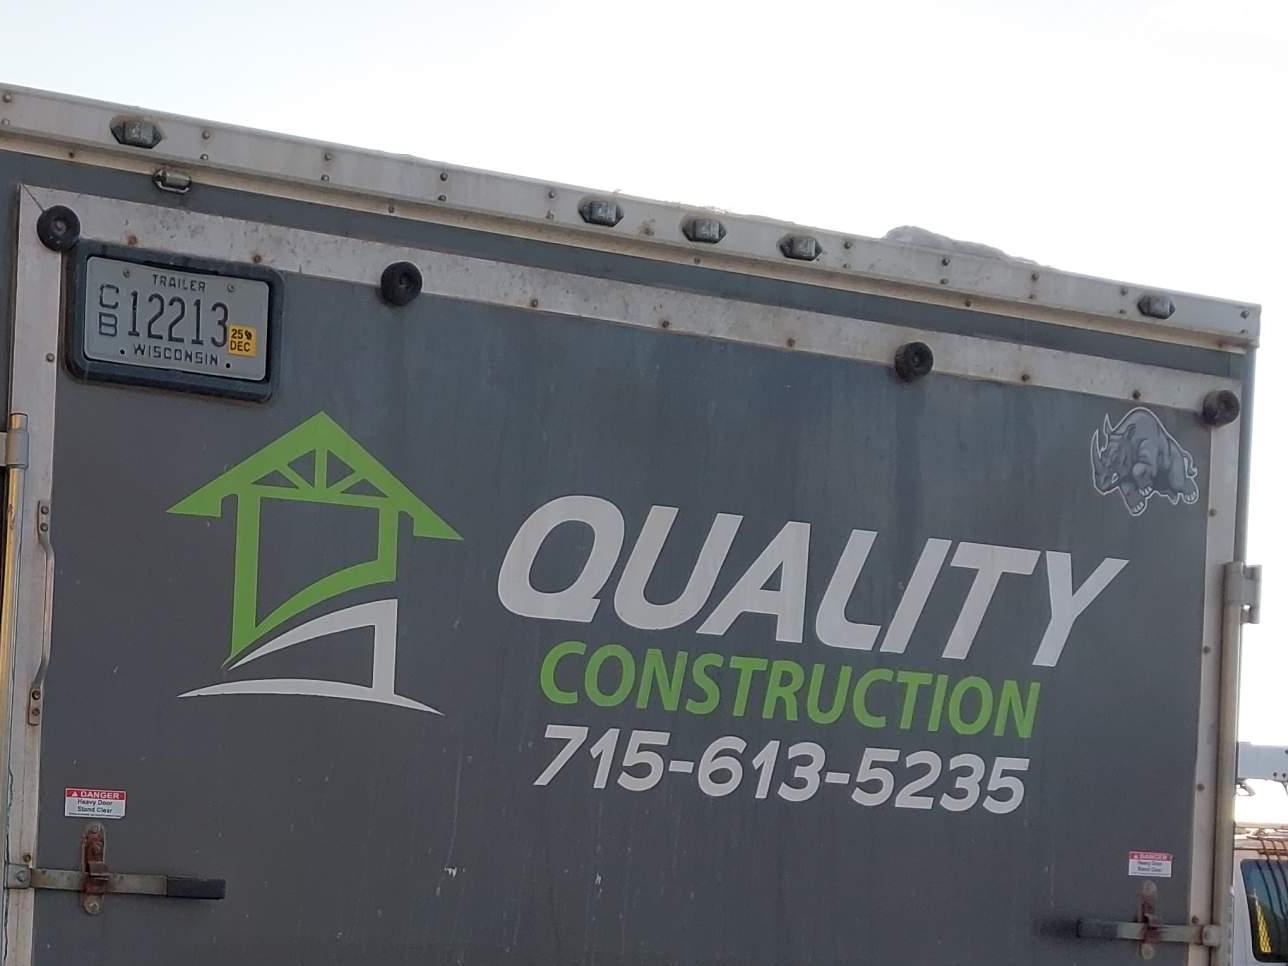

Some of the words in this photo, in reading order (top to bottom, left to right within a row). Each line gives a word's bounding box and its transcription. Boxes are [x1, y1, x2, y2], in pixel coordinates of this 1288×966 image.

[153, 274, 206, 292] TRAILER
[128, 290, 229, 347] 12213
[231, 328, 244, 340] 25
[134, 344, 218, 366] WISCONSIN
[230, 340, 251, 352] DEC
[498, 495, 1130, 667] QUALITY
[540, 641, 1041, 738] CONSTRUCTION
[533, 724, 1030, 814] 715-613-5235
[80, 791, 120, 800] DANGER
